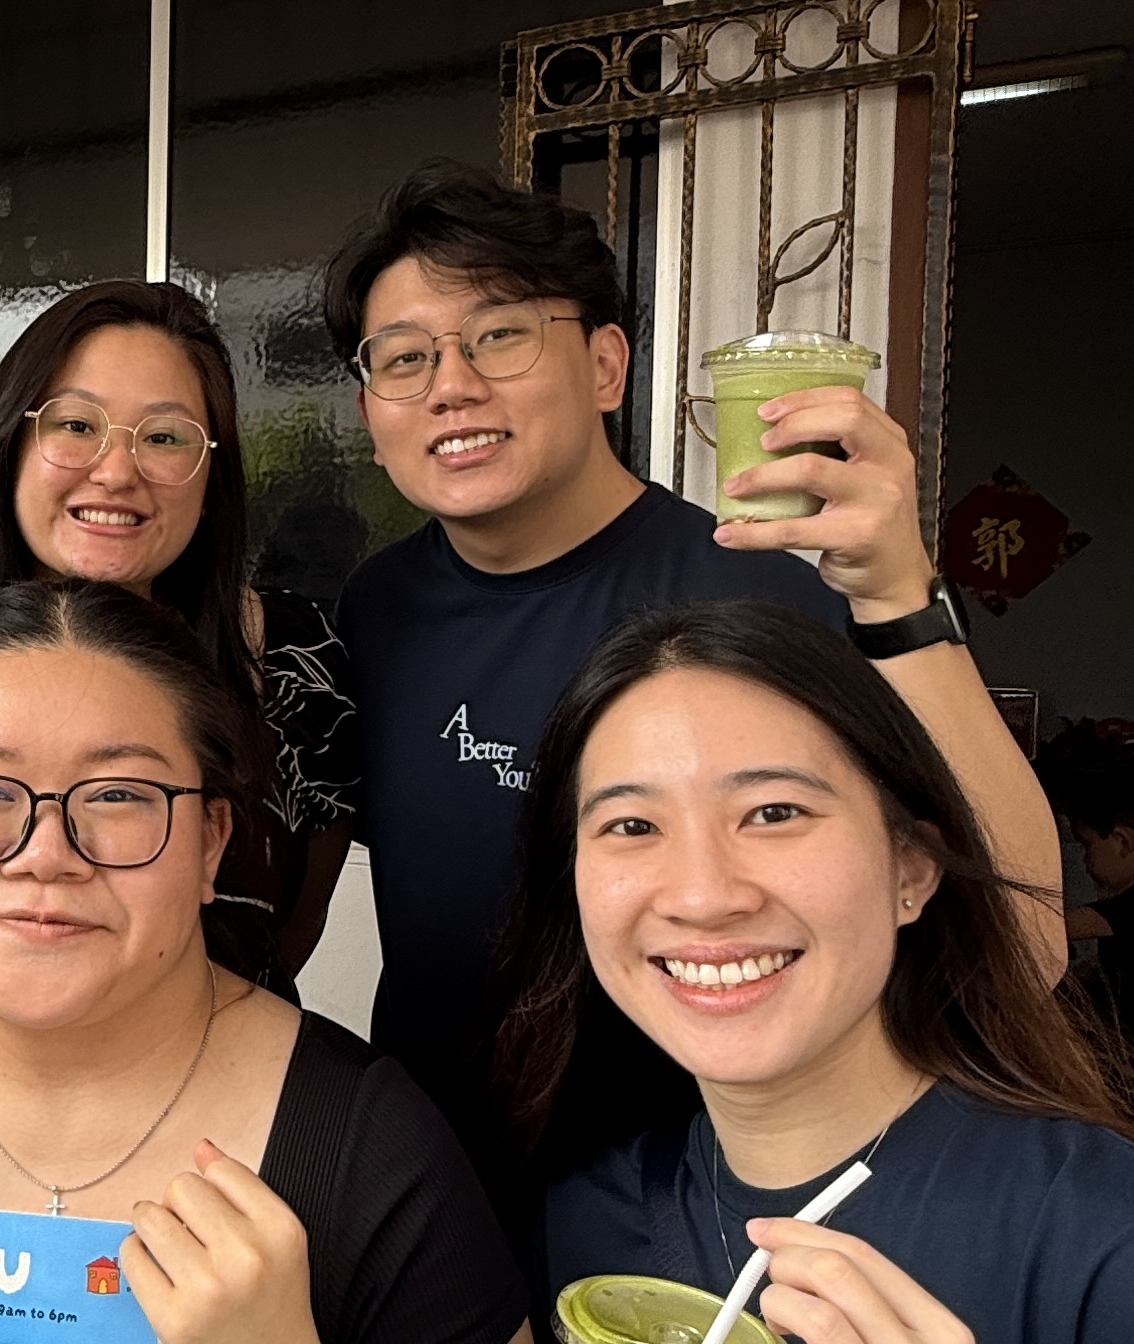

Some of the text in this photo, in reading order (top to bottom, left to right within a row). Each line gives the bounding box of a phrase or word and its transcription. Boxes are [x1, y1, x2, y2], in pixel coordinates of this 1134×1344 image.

[971, 517, 1025, 579] 郭
[439, 703, 469, 739] A
[458, 733, 517, 762] Better
[492, 761, 531, 791] You
[30, 1308, 45, 1319] to
[49, 1309, 77, 1323] 6pm
